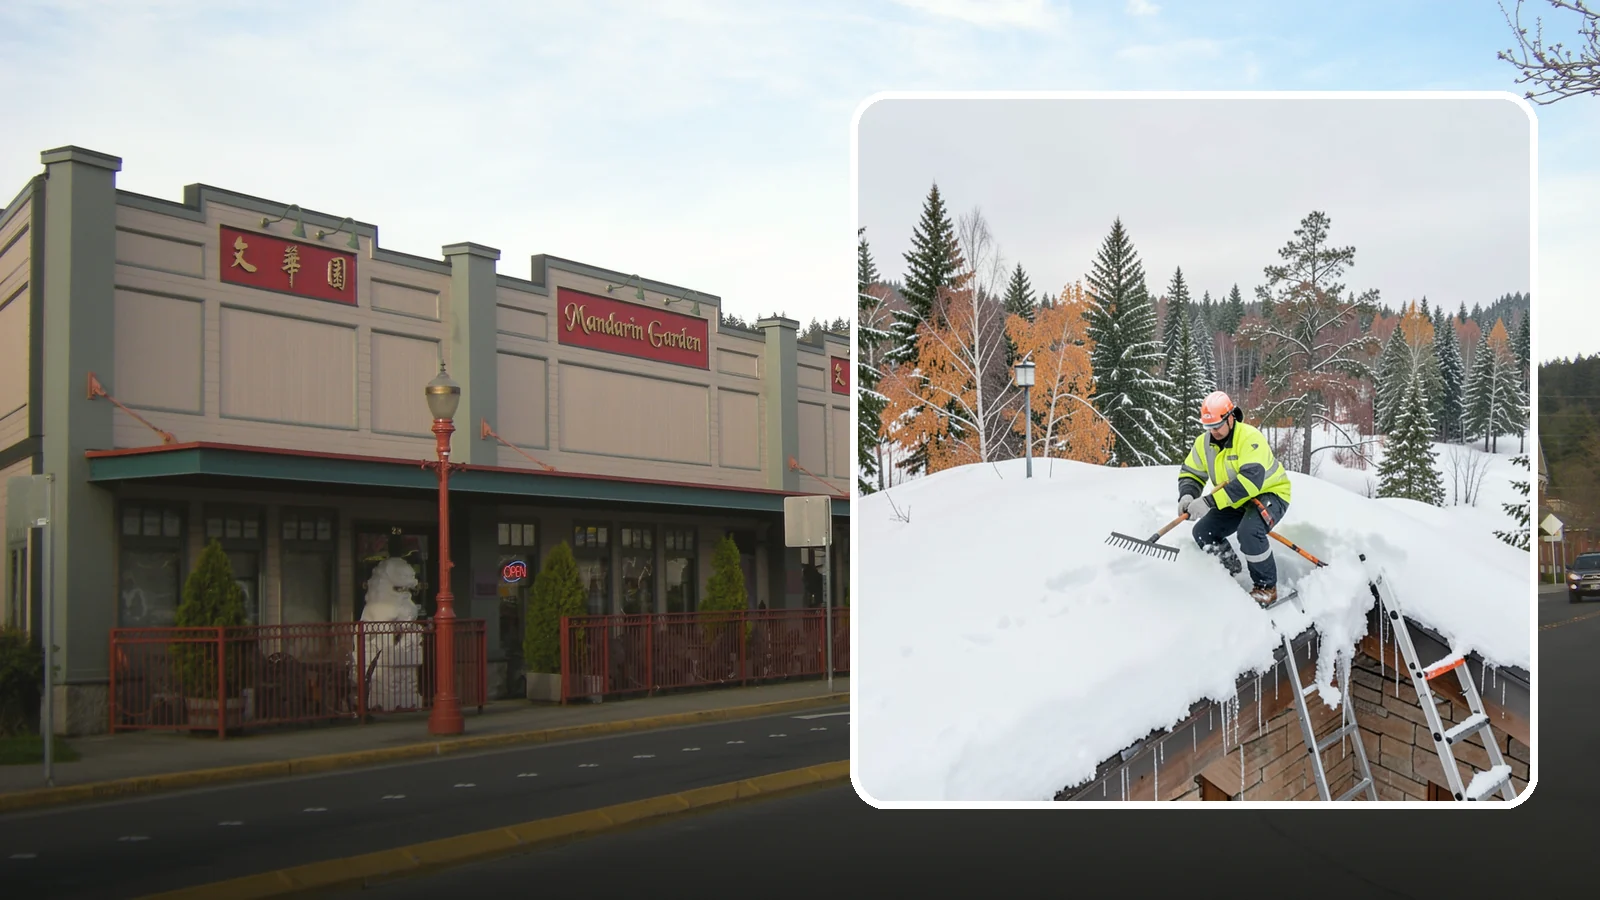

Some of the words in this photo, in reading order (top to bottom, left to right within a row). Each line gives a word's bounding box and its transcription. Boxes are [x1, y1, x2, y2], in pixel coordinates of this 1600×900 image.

[231, 236, 346, 290] 文華園
[564, 302, 643, 340] Mandarin
[648, 320, 701, 352] Garden
[504, 565, 526, 578] OPEN
